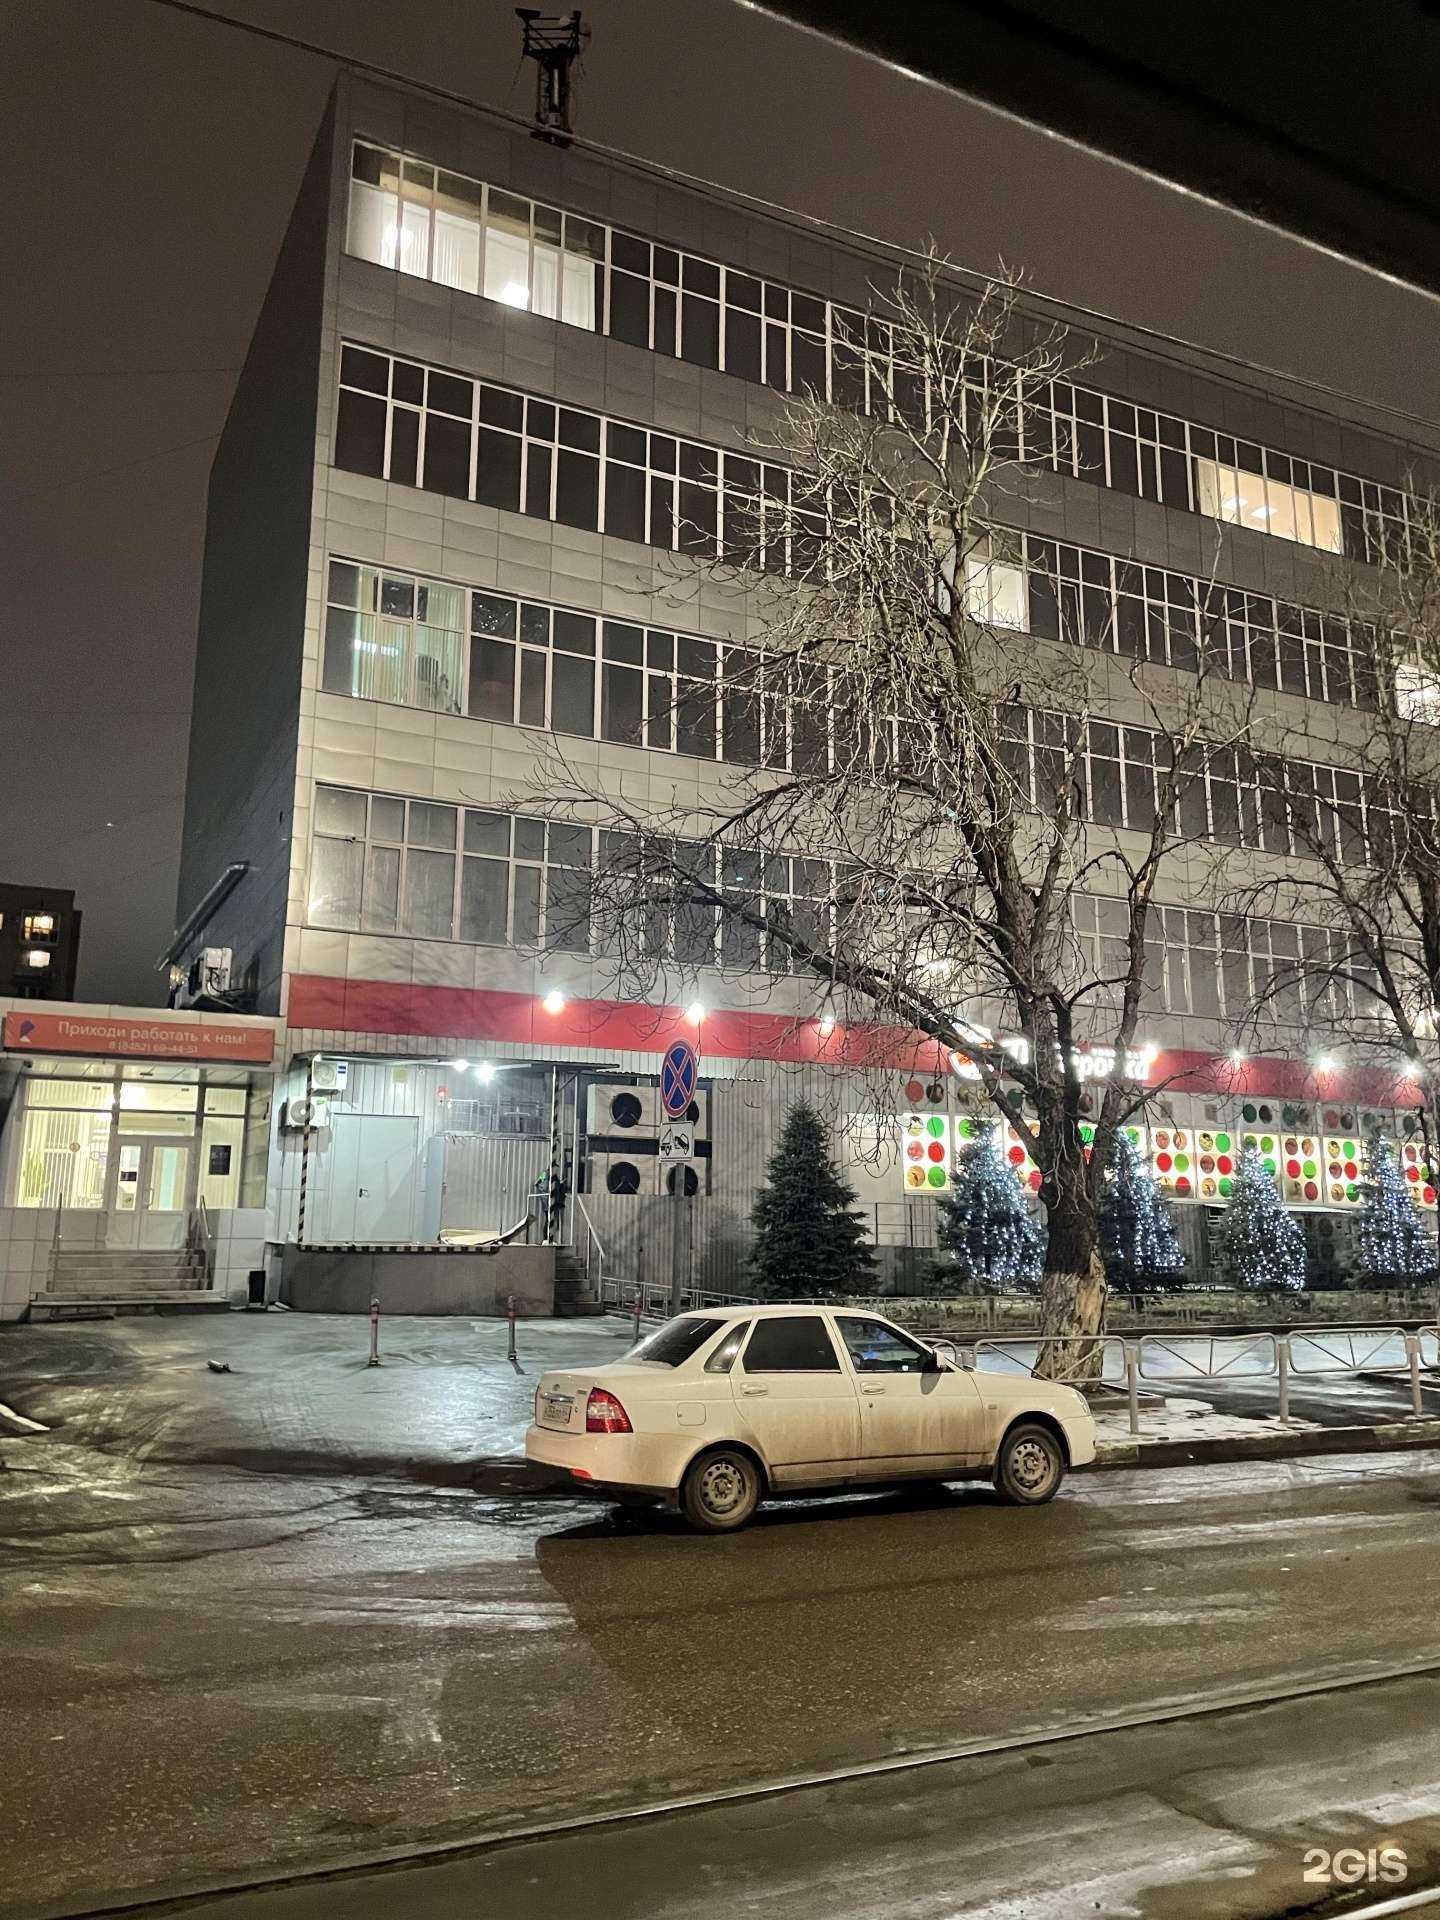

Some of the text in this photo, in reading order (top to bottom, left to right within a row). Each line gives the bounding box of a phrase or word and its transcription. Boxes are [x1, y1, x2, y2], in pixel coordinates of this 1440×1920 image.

[58, 1021, 247, 1045] Приходи работать к нам!
